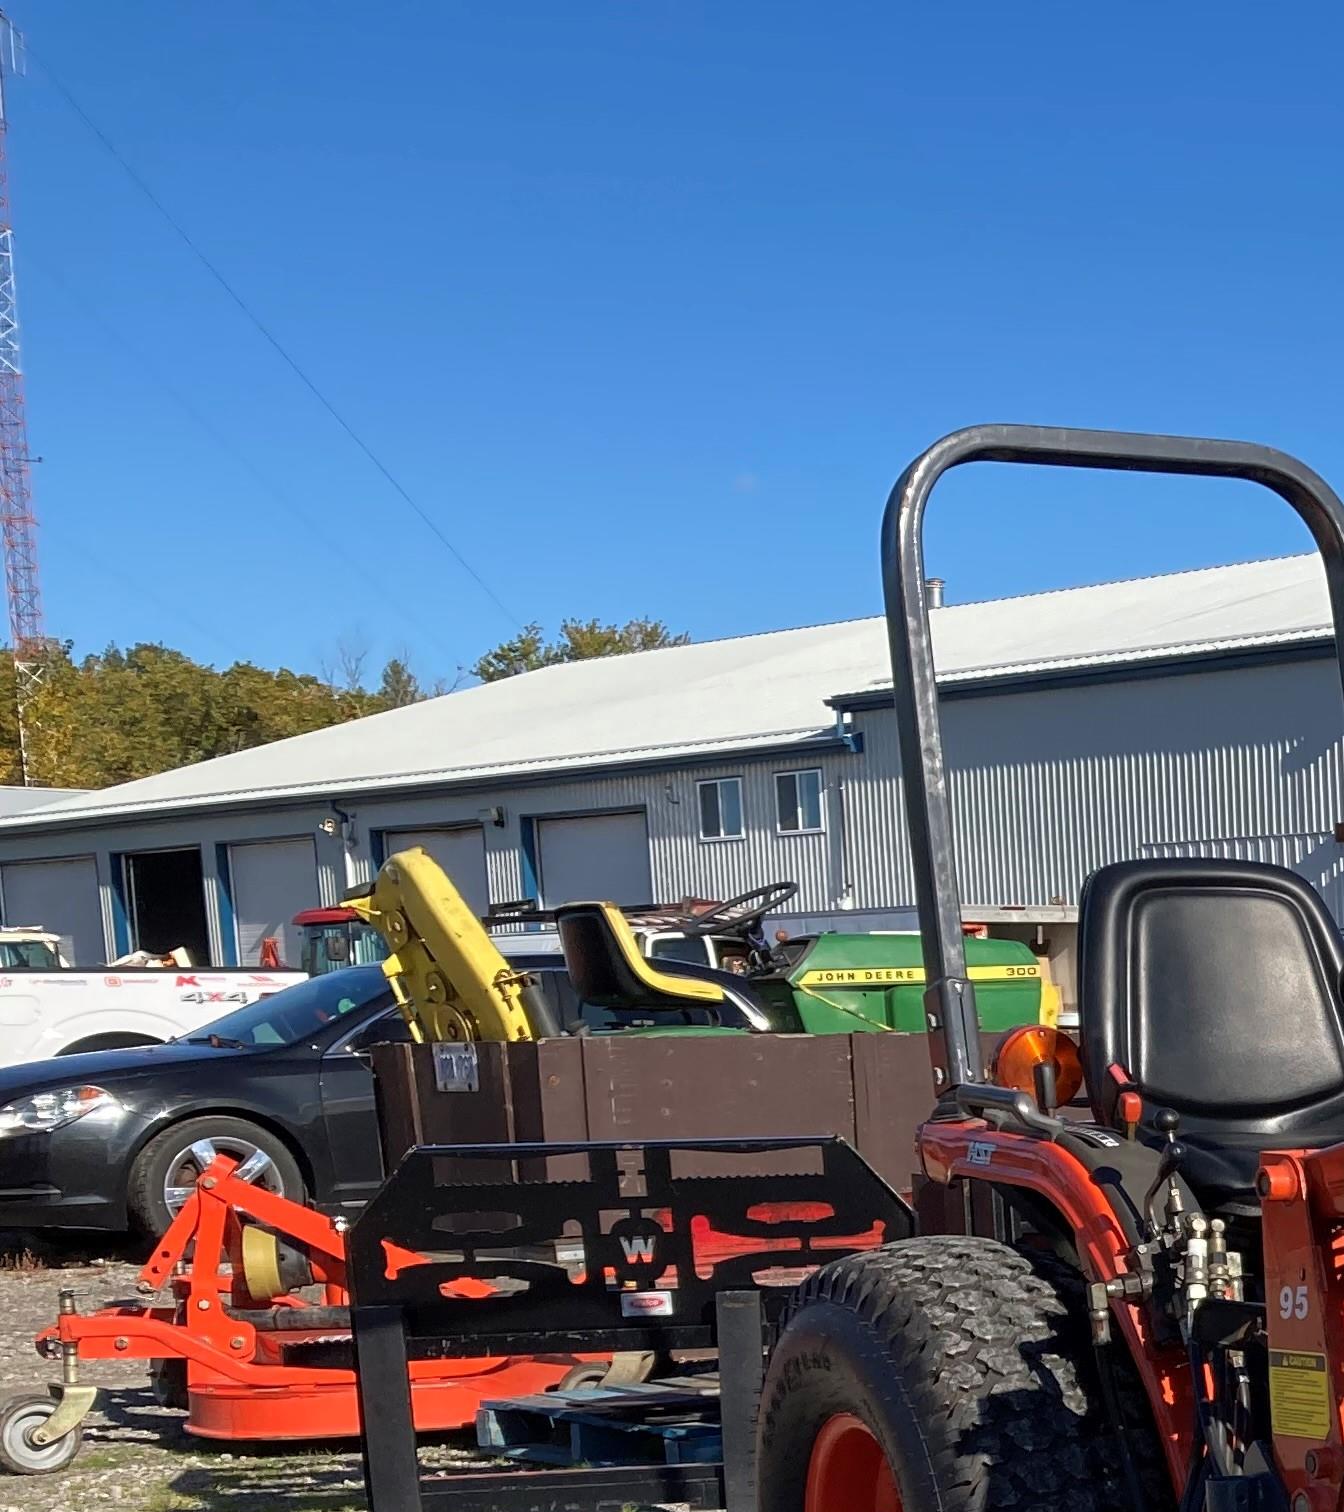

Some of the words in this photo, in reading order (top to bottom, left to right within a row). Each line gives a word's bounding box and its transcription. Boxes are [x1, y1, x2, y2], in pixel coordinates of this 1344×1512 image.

[816, 972, 856, 982] JOHN
[865, 970, 915, 981] DEERE
[1006, 966, 1037, 977] 300
[619, 1235, 656, 1265] W
[1279, 1285, 1309, 1320] 95
